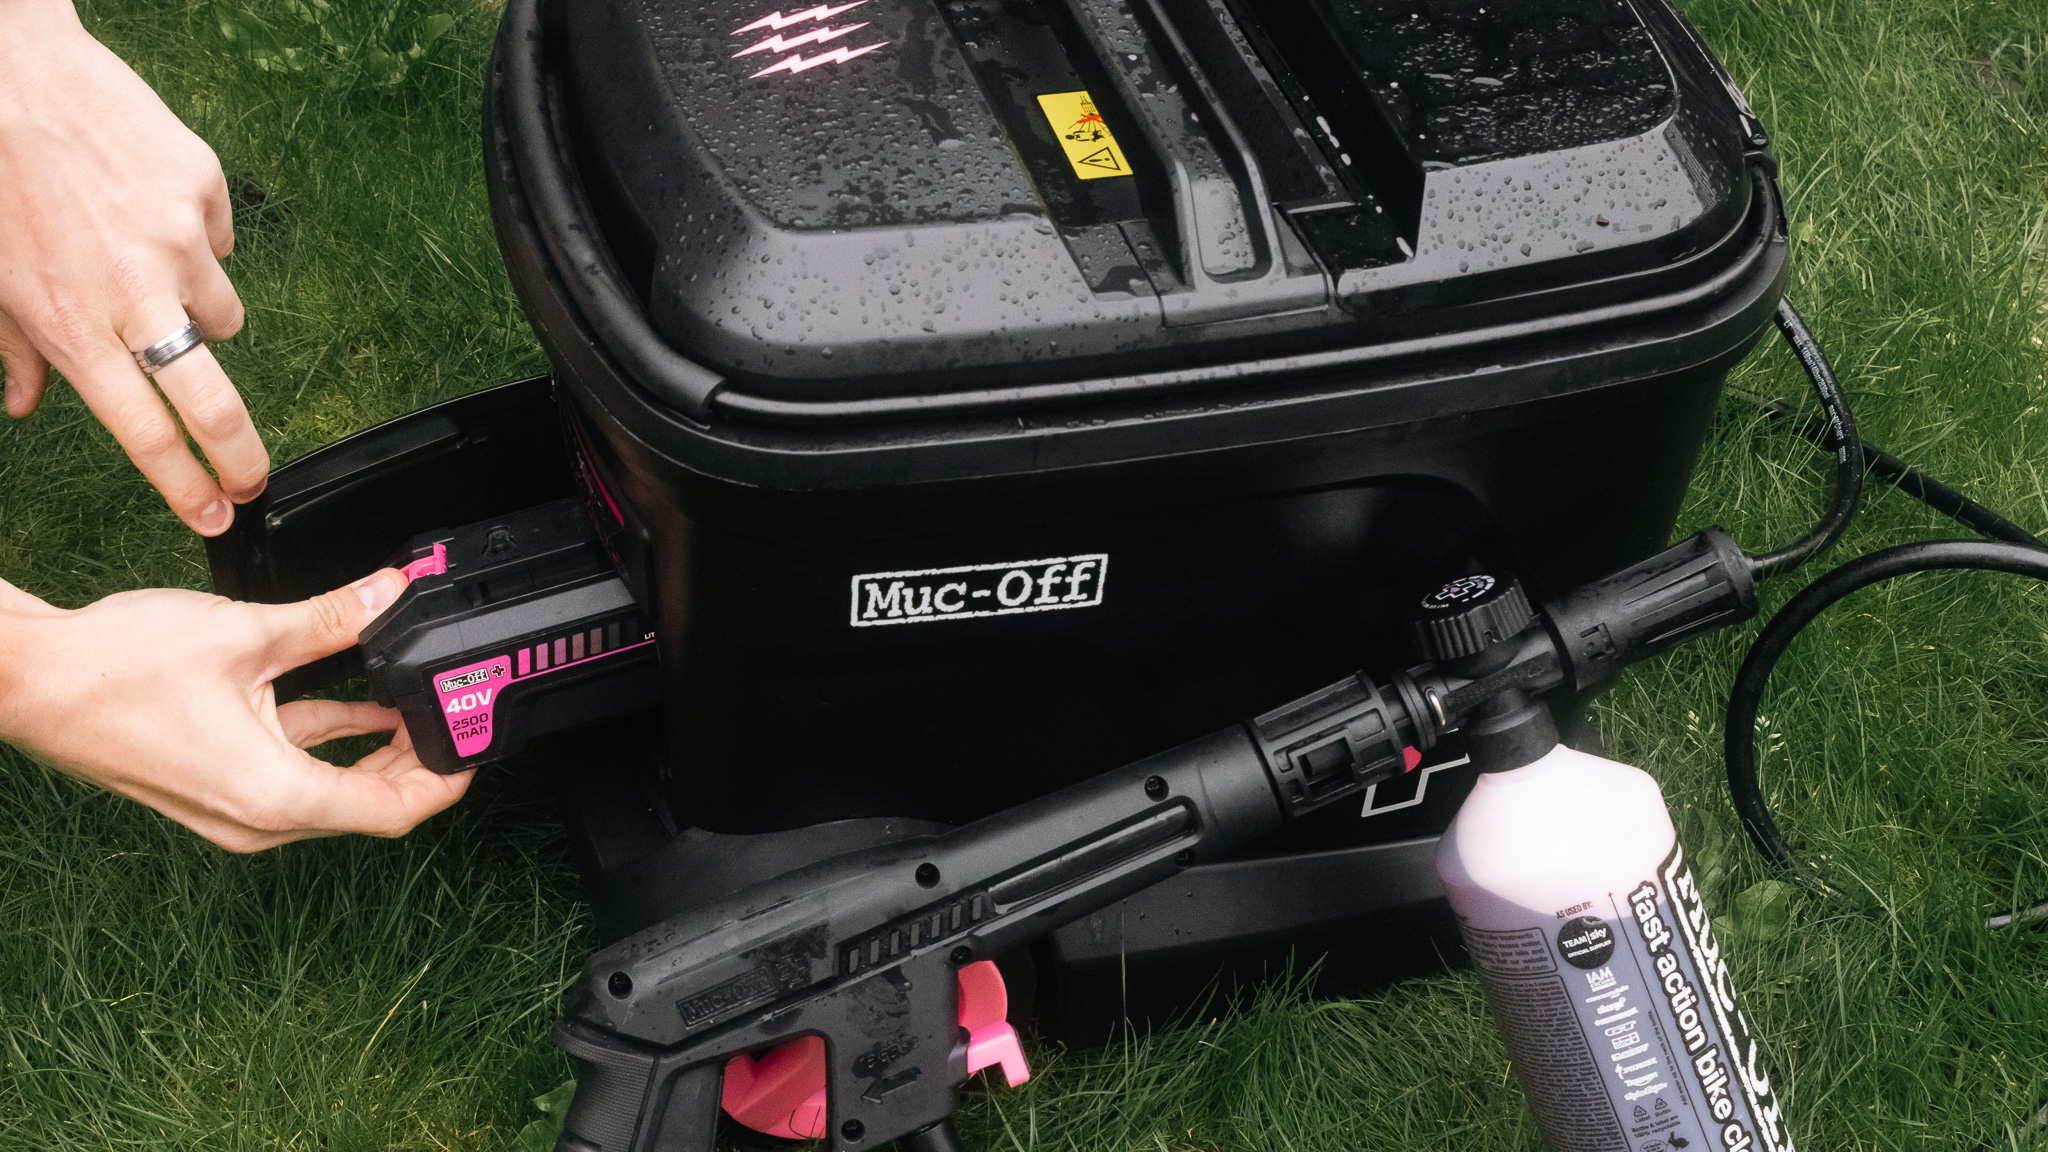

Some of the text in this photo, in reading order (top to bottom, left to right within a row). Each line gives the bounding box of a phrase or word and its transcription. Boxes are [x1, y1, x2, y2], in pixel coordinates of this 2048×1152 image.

[863, 562, 1096, 618] Muc-Off
[443, 669, 487, 691] Muc-Off
[446, 688, 492, 714] 40V
[452, 713, 489, 731] 2500
[456, 725, 488, 741] mAh
[1556, 901, 1592, 919] AS USED BY:
[1563, 927, 1606, 948] TEAM sky
[1567, 940, 1612, 958] OFFICIAL SUPPLIER
[1585, 966, 1613, 985] IAM
[1631, 885, 1671, 952] fast
[1657, 953, 1706, 1051] action
[1695, 1050, 1733, 1120] bike
[1634, 1115, 1651, 1123] Label
[1652, 1121, 1681, 1133] recyclable
[1655, 1117, 1669, 1126] label
